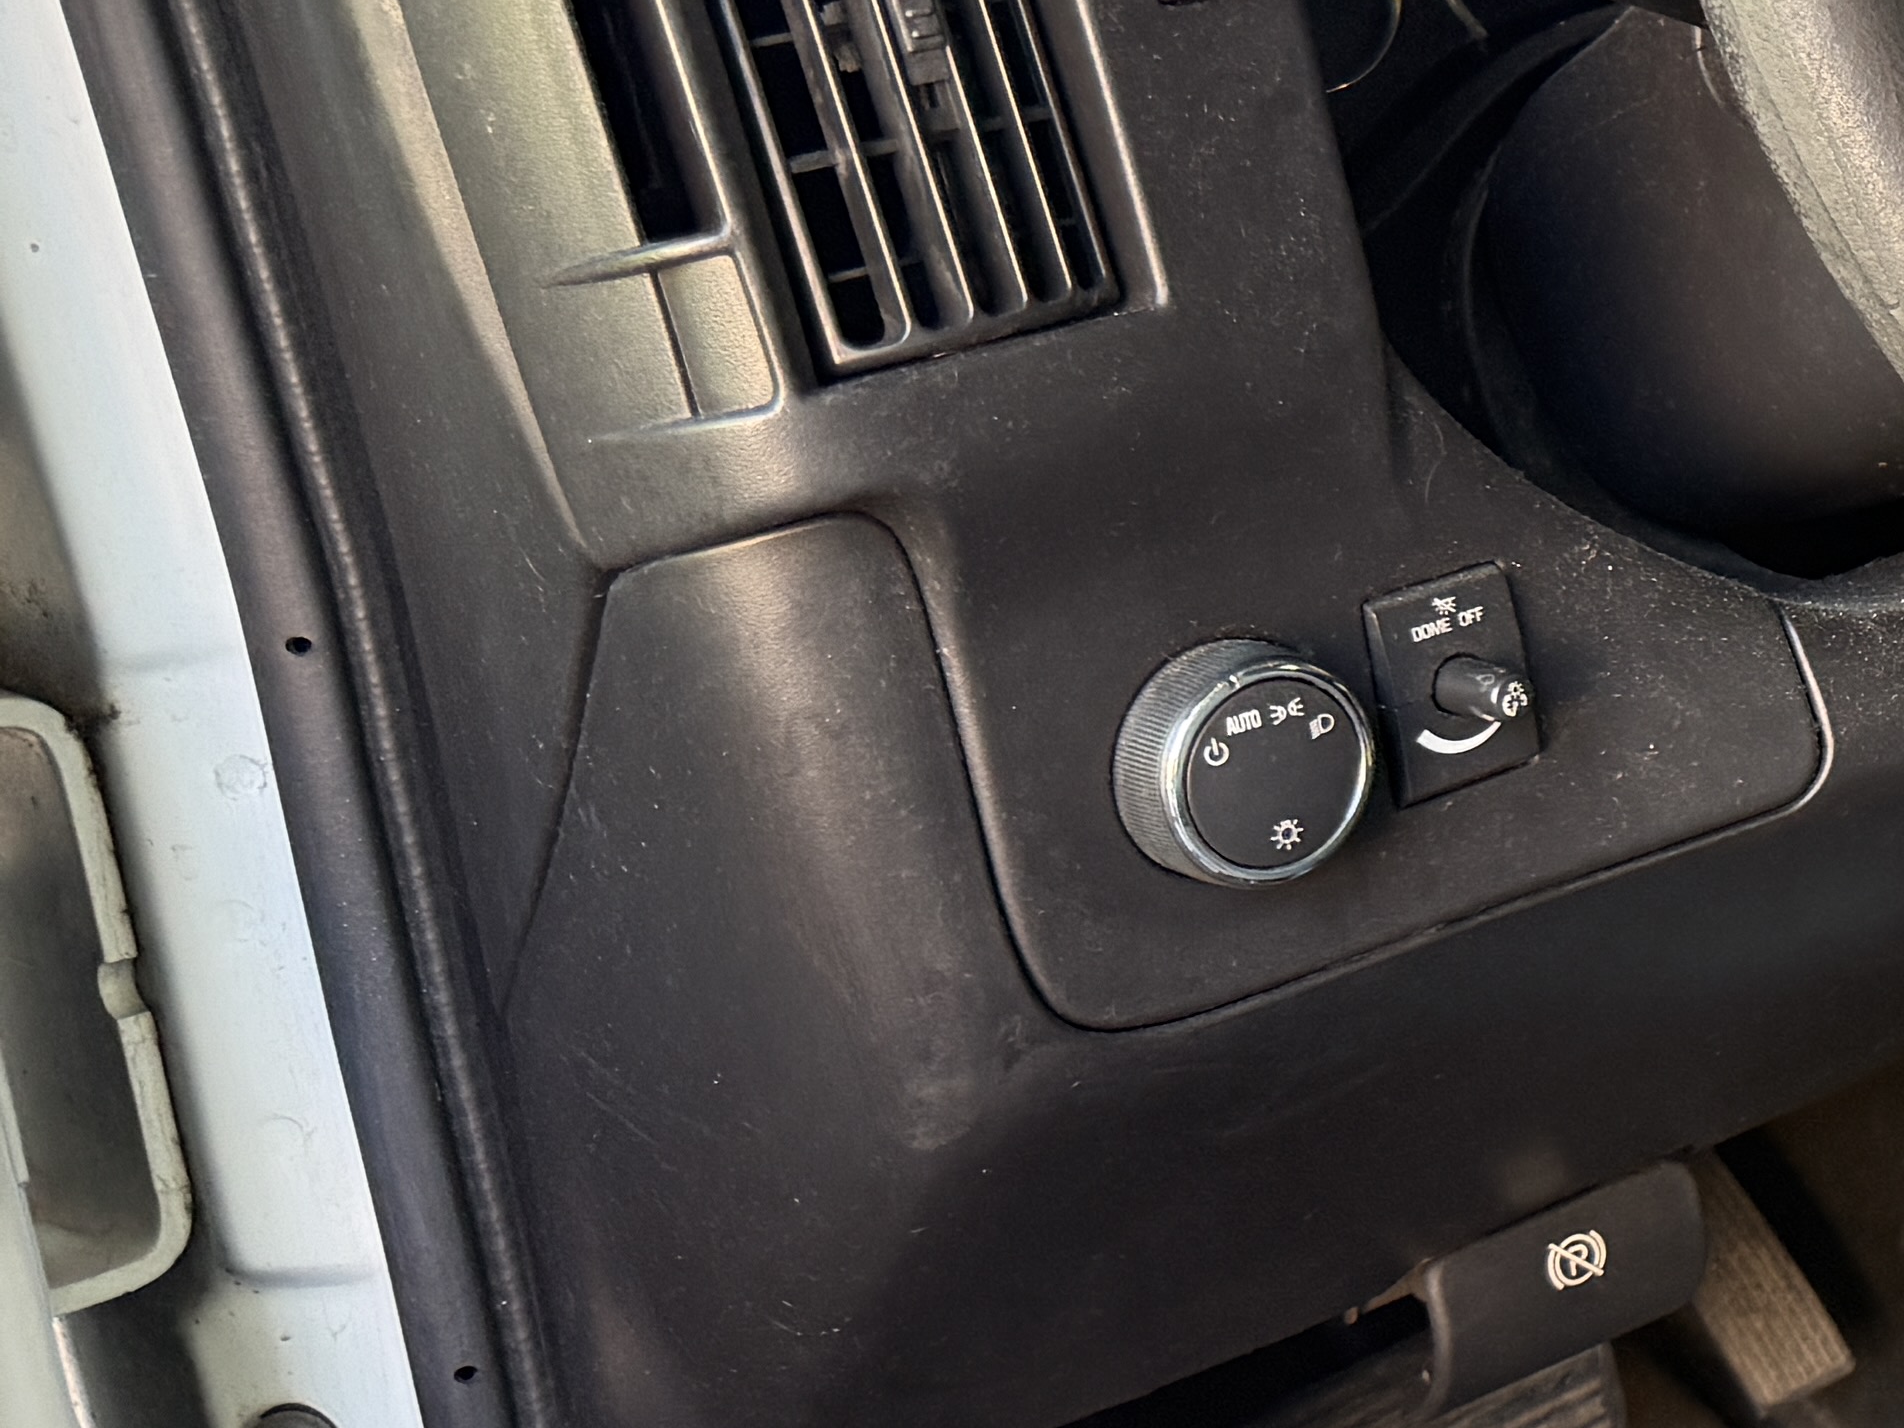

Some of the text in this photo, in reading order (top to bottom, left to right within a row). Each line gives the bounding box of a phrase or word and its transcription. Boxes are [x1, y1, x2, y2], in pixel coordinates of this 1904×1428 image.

[1410, 605, 1484, 643] DOME OFF
[1225, 707, 1263, 737] AUTO
